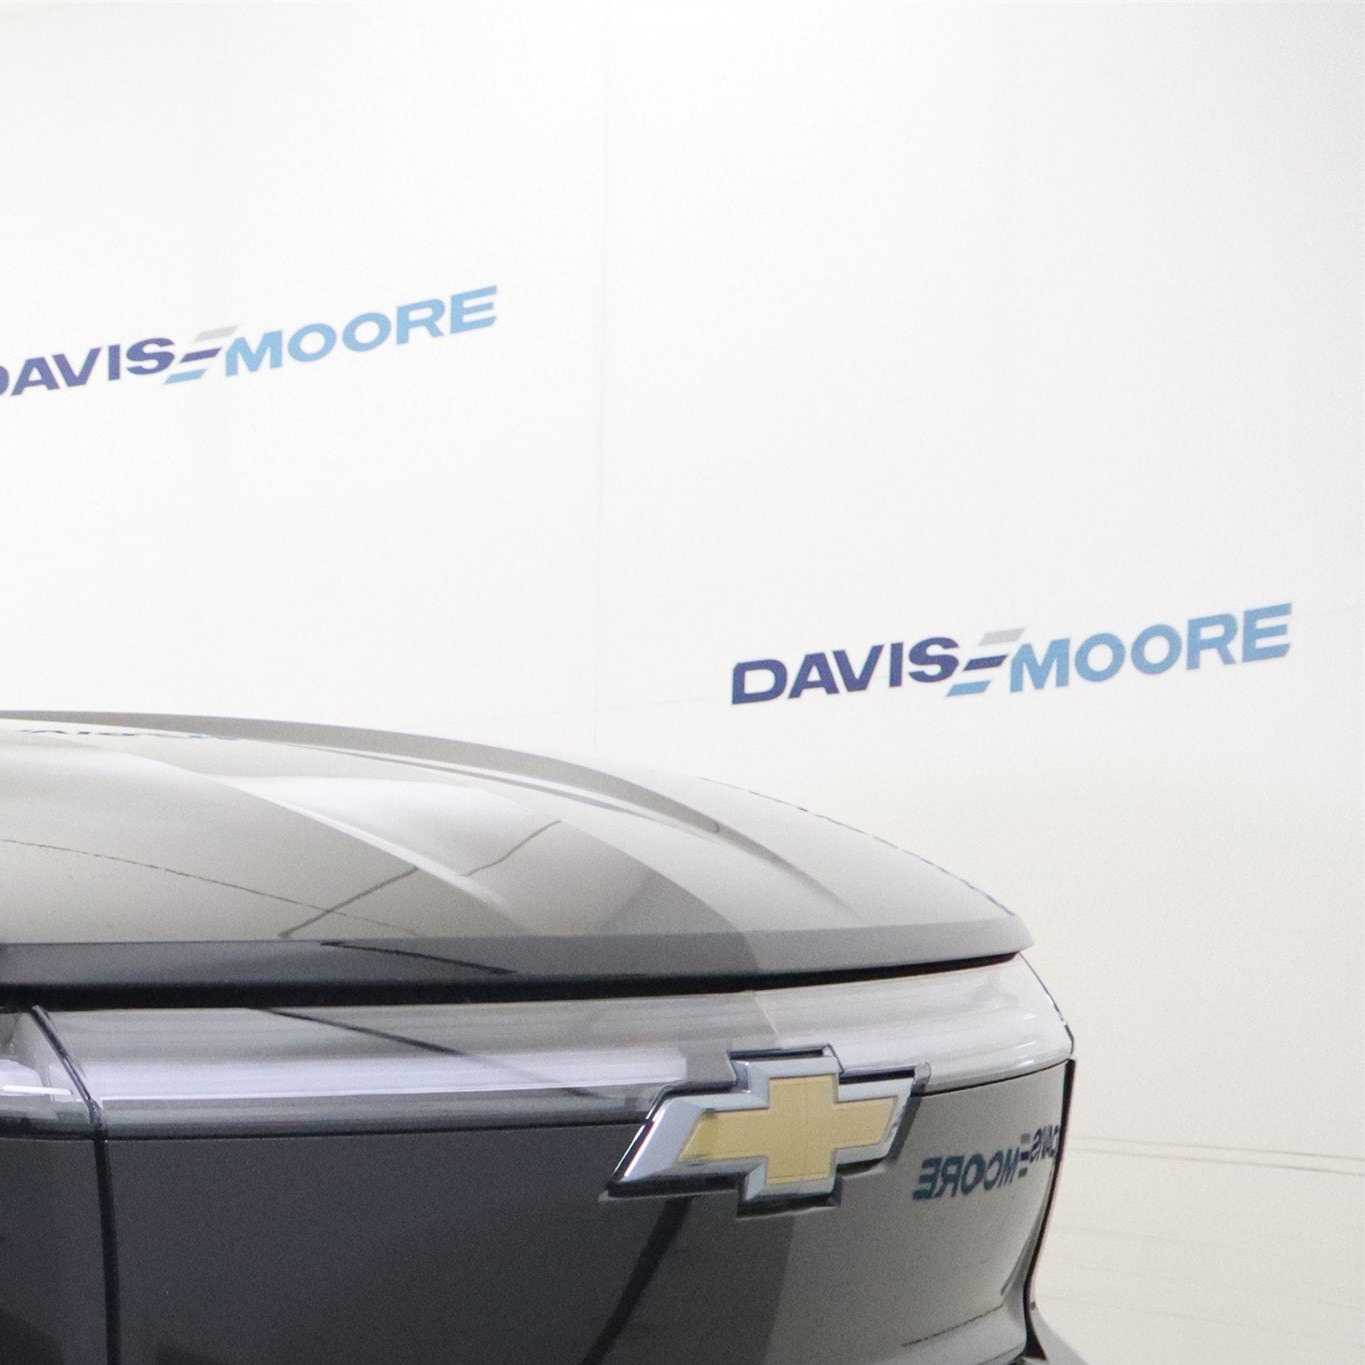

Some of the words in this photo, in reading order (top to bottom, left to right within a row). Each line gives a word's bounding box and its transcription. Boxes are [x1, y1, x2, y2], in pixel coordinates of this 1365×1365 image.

[224, 285, 498, 378] MOORE
[731, 636, 959, 706] DAVIS
[1009, 602, 1293, 694] MOORE
